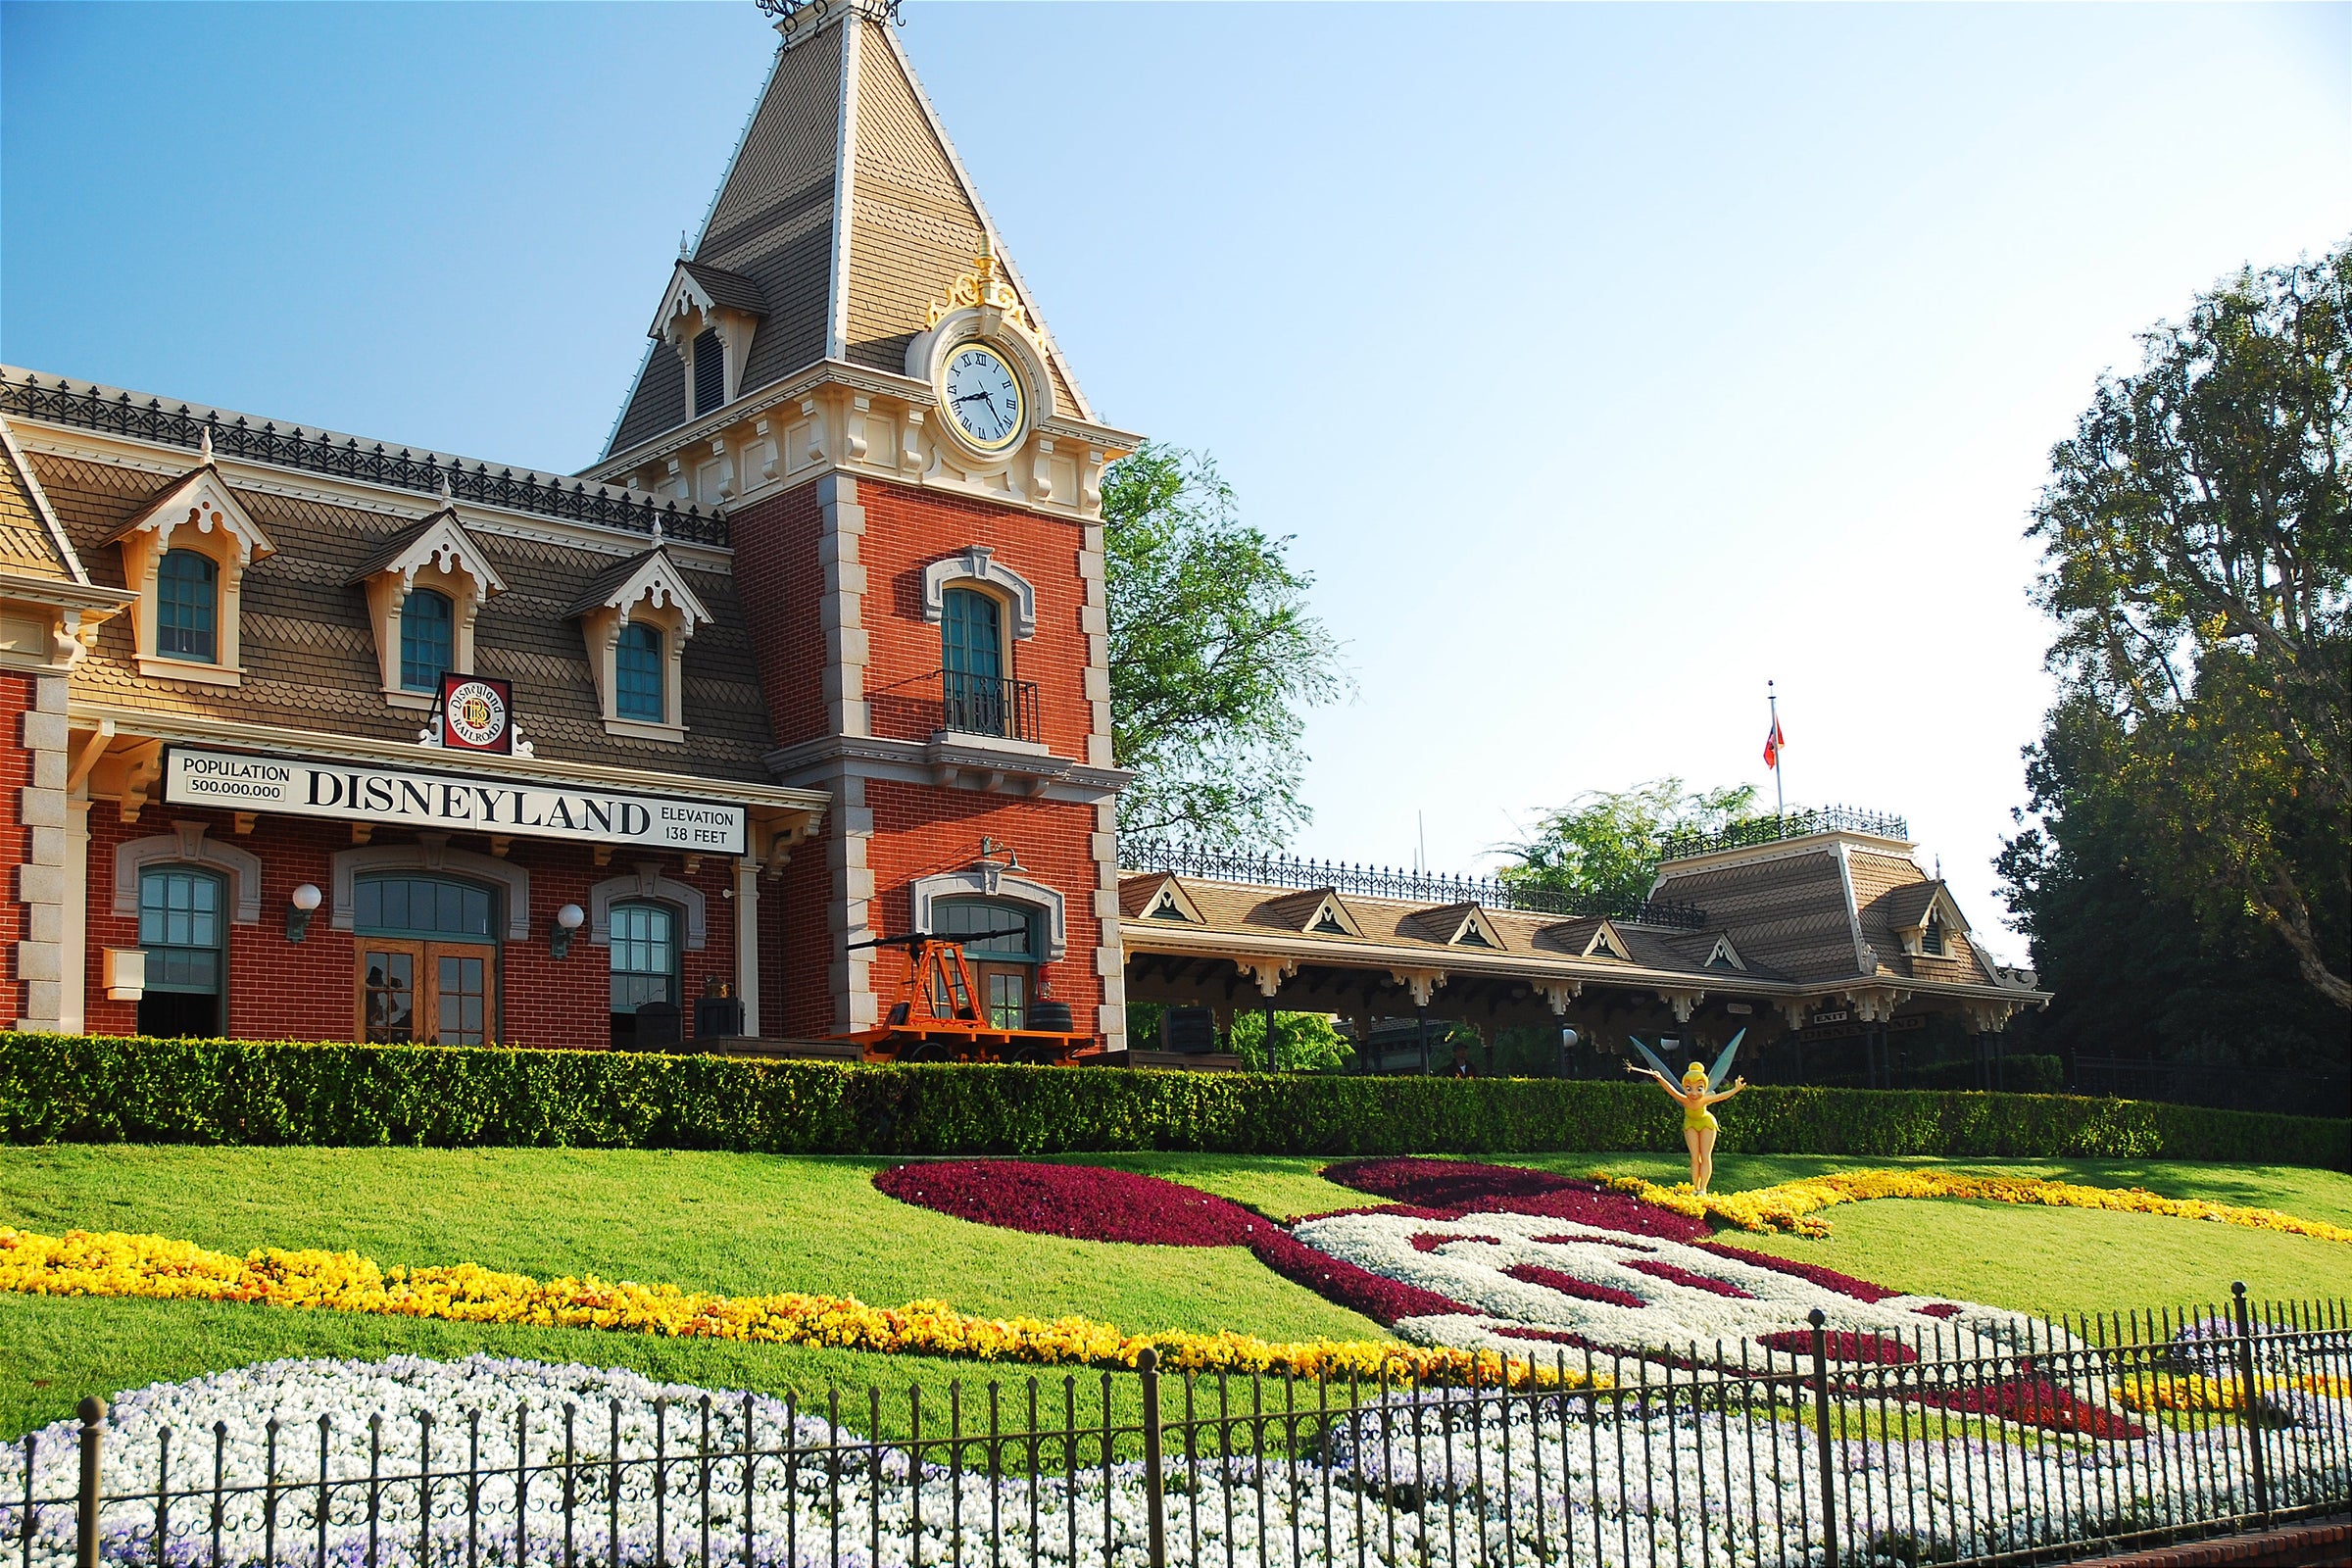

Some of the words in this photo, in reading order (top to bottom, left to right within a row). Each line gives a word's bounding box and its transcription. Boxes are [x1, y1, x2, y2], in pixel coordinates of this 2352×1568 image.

[960, 354, 972, 368] XI
[975, 353, 987, 367] XII
[951, 365, 961, 377] X
[948, 383, 956, 395] IX
[1002, 380, 1012, 389] II
[1006, 398, 1016, 411] III
[961, 416, 973, 432] VII
[978, 427, 987, 440] VI
[451, 685, 504, 713] Disneyland
[454, 718, 501, 742] RAILROAD
[183, 758, 290, 782] POPULATION
[304, 769, 651, 835] DISNEYLAND
[661, 807, 734, 826] ELEVATION
[665, 826, 688, 841] 138
[694, 829, 727, 844] FEET
[1817, 1012, 1844, 1022] EXIT
